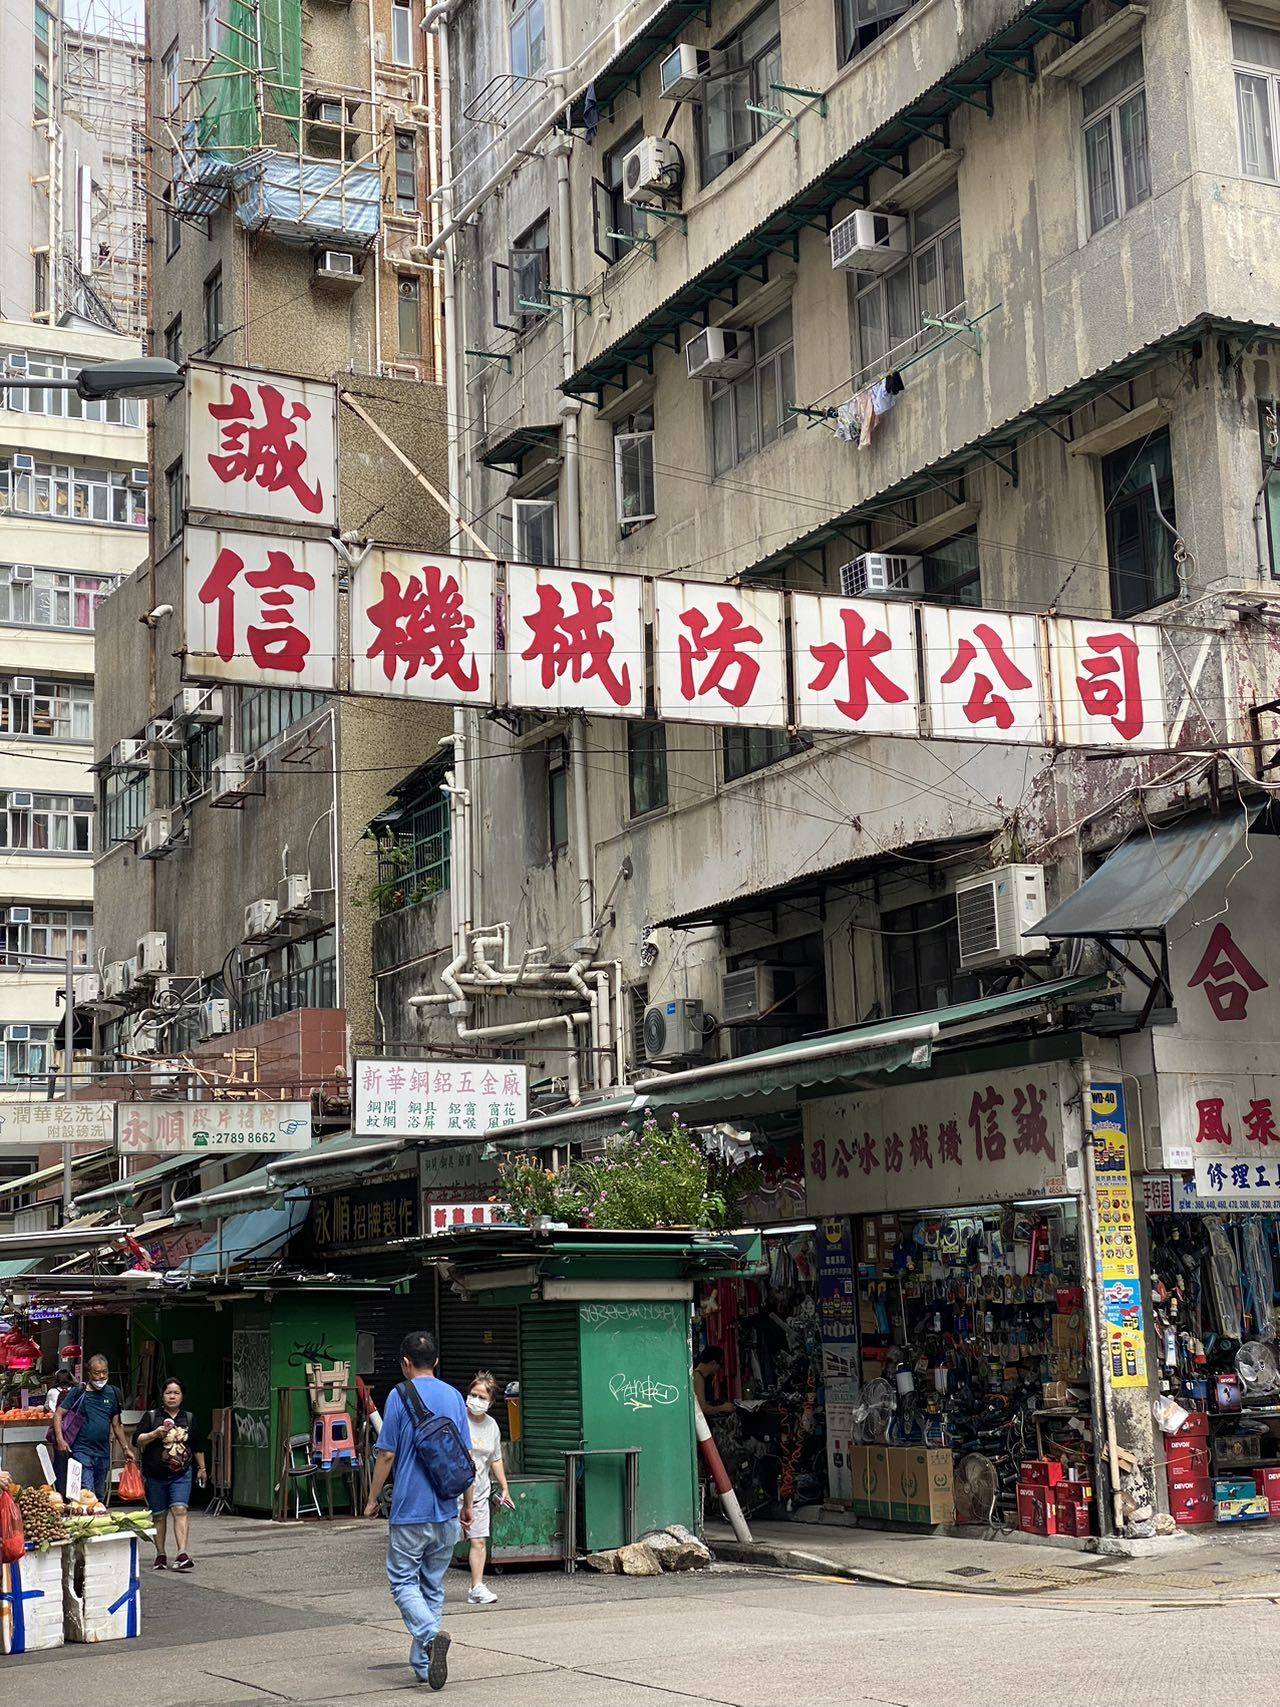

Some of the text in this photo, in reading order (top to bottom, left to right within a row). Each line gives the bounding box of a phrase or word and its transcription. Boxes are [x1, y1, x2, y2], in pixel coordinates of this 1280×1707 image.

[1187, 922, 1269, 1021] 合
[361, 1066, 522, 1096] 新華鋼鋁五金廠
[1091, 1092, 1115, 1104] WD-40
[367, 1100, 517, 1117] 鋼閘 鋼具 鋁窗 窗花
[122, 1107, 278, 1146] 永順 膠片招牌
[366, 1115, 396, 1128] 蚊網
[248, 1132, 276, 1144] 8662
[1174, 1482, 1194, 1490] DEVON
